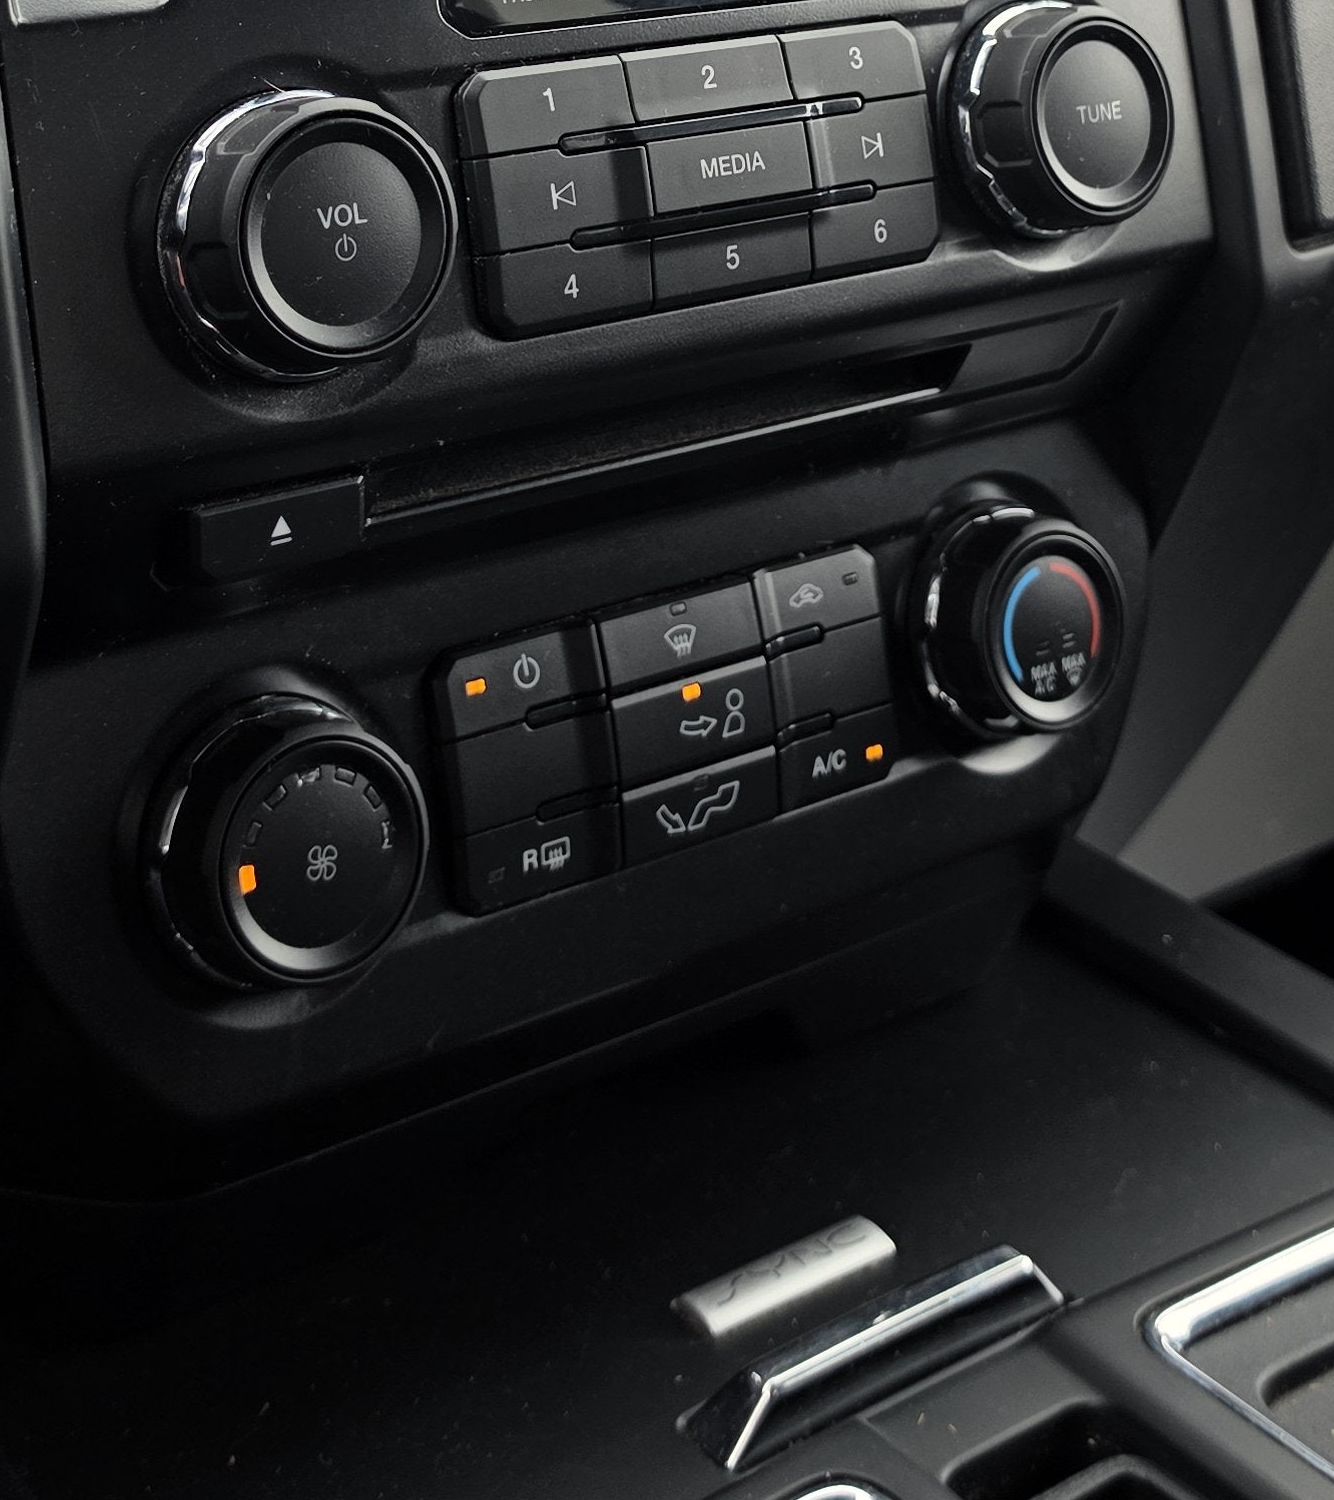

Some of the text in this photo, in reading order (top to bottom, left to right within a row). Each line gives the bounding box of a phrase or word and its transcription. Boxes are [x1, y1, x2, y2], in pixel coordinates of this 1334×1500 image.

[848, 46, 864, 70] 3
[701, 64, 717, 90] 2
[542, 87, 556, 112] 1
[1075, 100, 1123, 125] TUNE
[699, 150, 766, 180] MEDIA
[316, 202, 369, 230] VOL
[873, 218, 888, 244] 6
[725, 244, 740, 271] 5
[564, 273, 579, 299] 4
[811, 748, 847, 779] A/C
[522, 849, 539, 873] R
